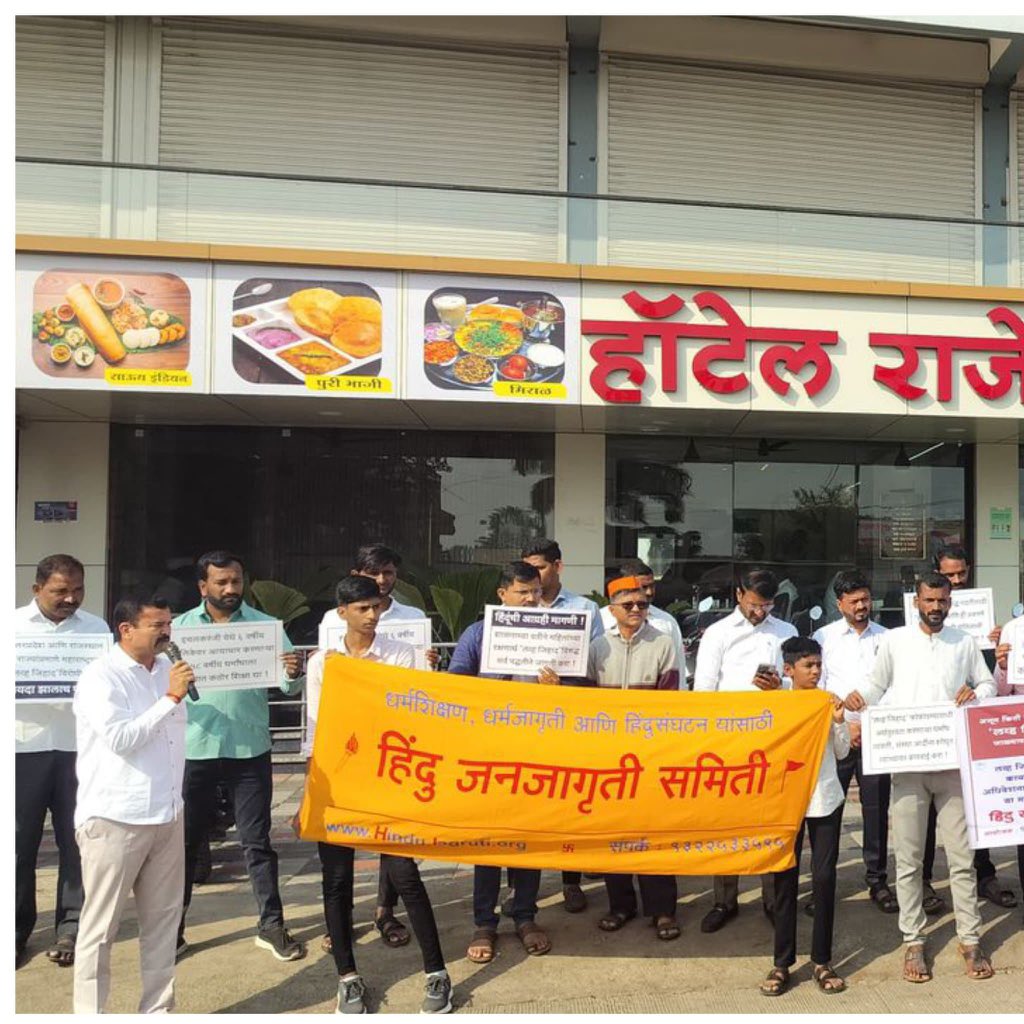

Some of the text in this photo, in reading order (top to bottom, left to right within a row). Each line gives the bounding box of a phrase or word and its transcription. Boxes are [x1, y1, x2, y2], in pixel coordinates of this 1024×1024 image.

[581, 291, 838, 404] हॉटेल
[317, 377, 381, 390] पुरी भाजी
[385, 689, 475, 726] धर्मशिक्षण,
[483, 703, 566, 735] धर्मजागृती
[573, 707, 617, 734] आणि
[716, 708, 773, 733] यांसाठी
[377, 731, 770, 814] हिंदु जनजागृती समिती
